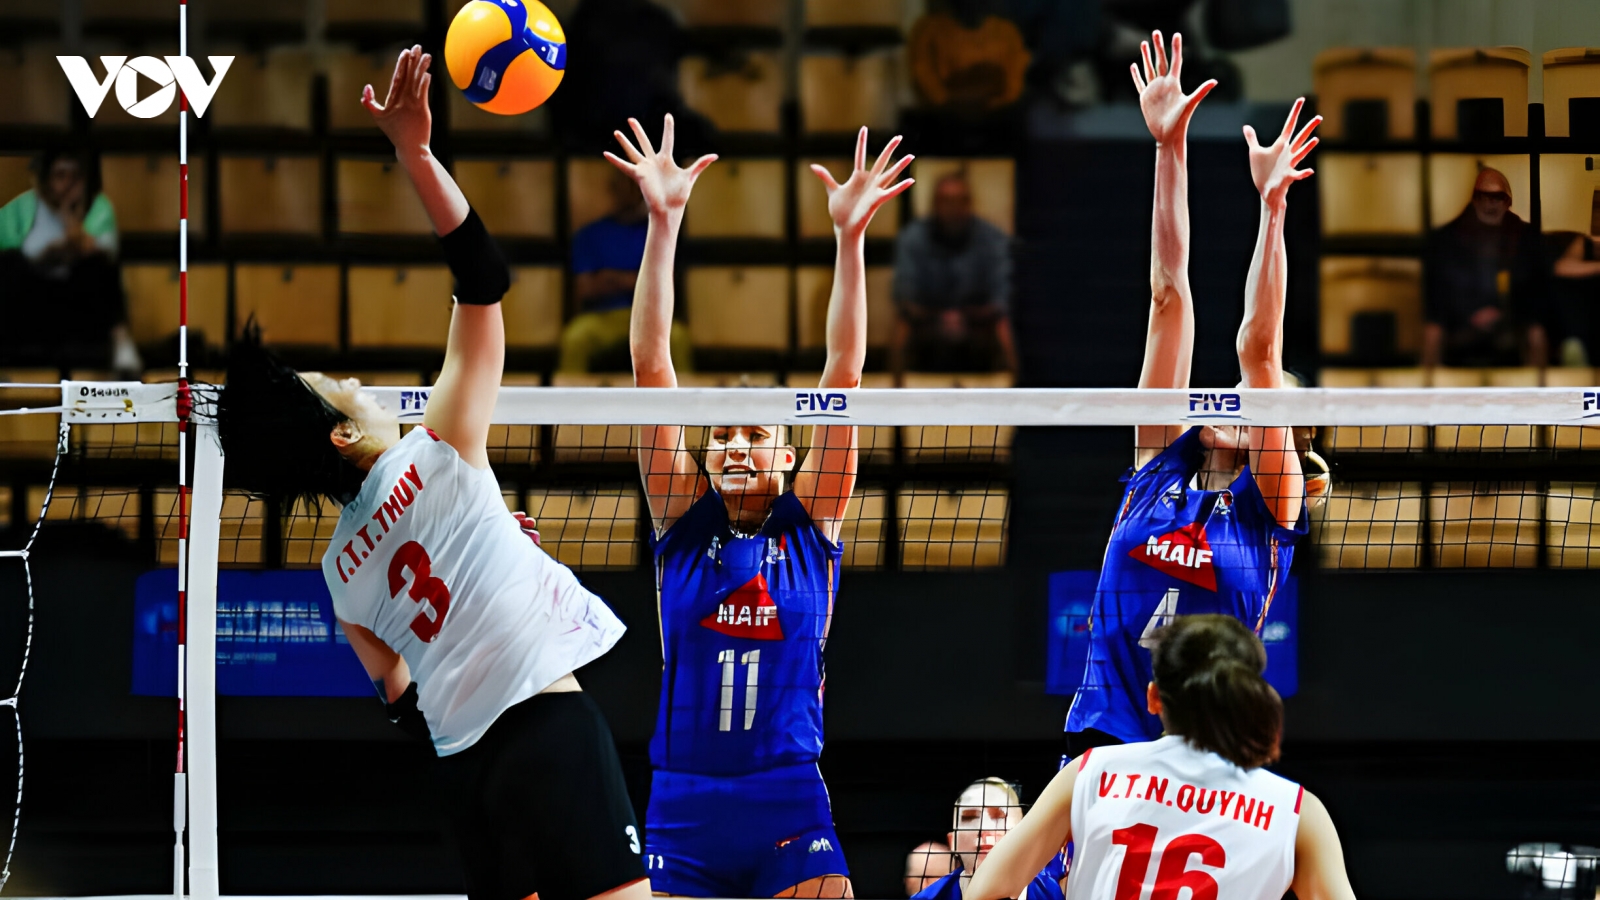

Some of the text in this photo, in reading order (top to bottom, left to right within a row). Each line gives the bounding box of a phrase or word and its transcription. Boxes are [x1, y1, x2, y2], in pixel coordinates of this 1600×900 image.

[796, 393, 847, 411] FIVB
[1189, 393, 1241, 412] FIVB
[1583, 392, 1600, 411] FI
[1146, 535, 1213, 569] MAIF
[387, 540, 451, 643] 3
[717, 603, 777, 626] MAIF
[718, 649, 761, 732] 11
[625, 825, 641, 854] 3
[1112, 823, 1226, 900] 16
